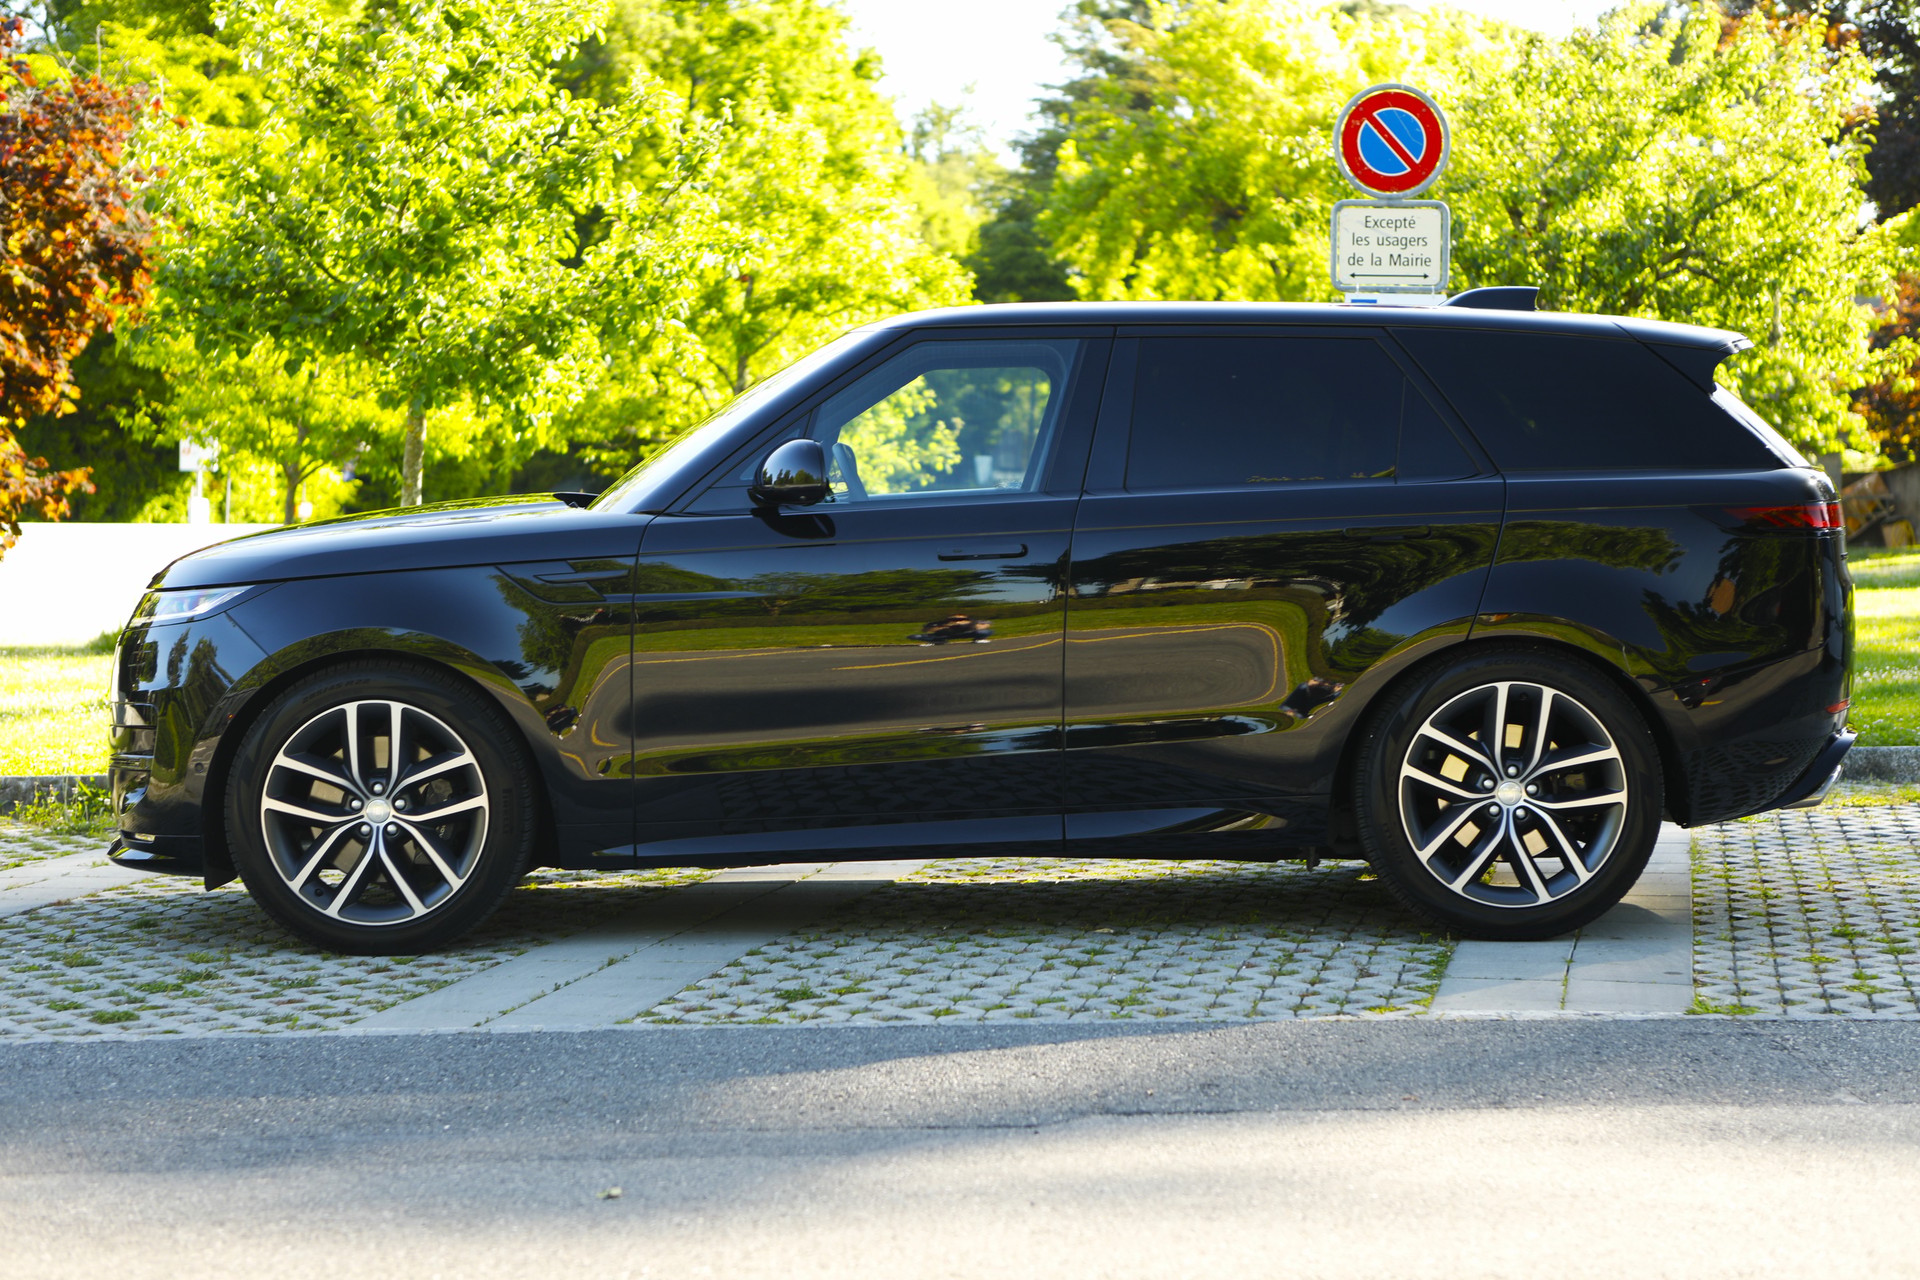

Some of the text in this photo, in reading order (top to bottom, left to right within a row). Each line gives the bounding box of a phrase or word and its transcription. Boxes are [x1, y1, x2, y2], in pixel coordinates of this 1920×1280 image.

[1364, 215, 1416, 232] Excepté
[1351, 232, 1428, 250] les usagers
[1347, 252, 1432, 267] de la Mairie
